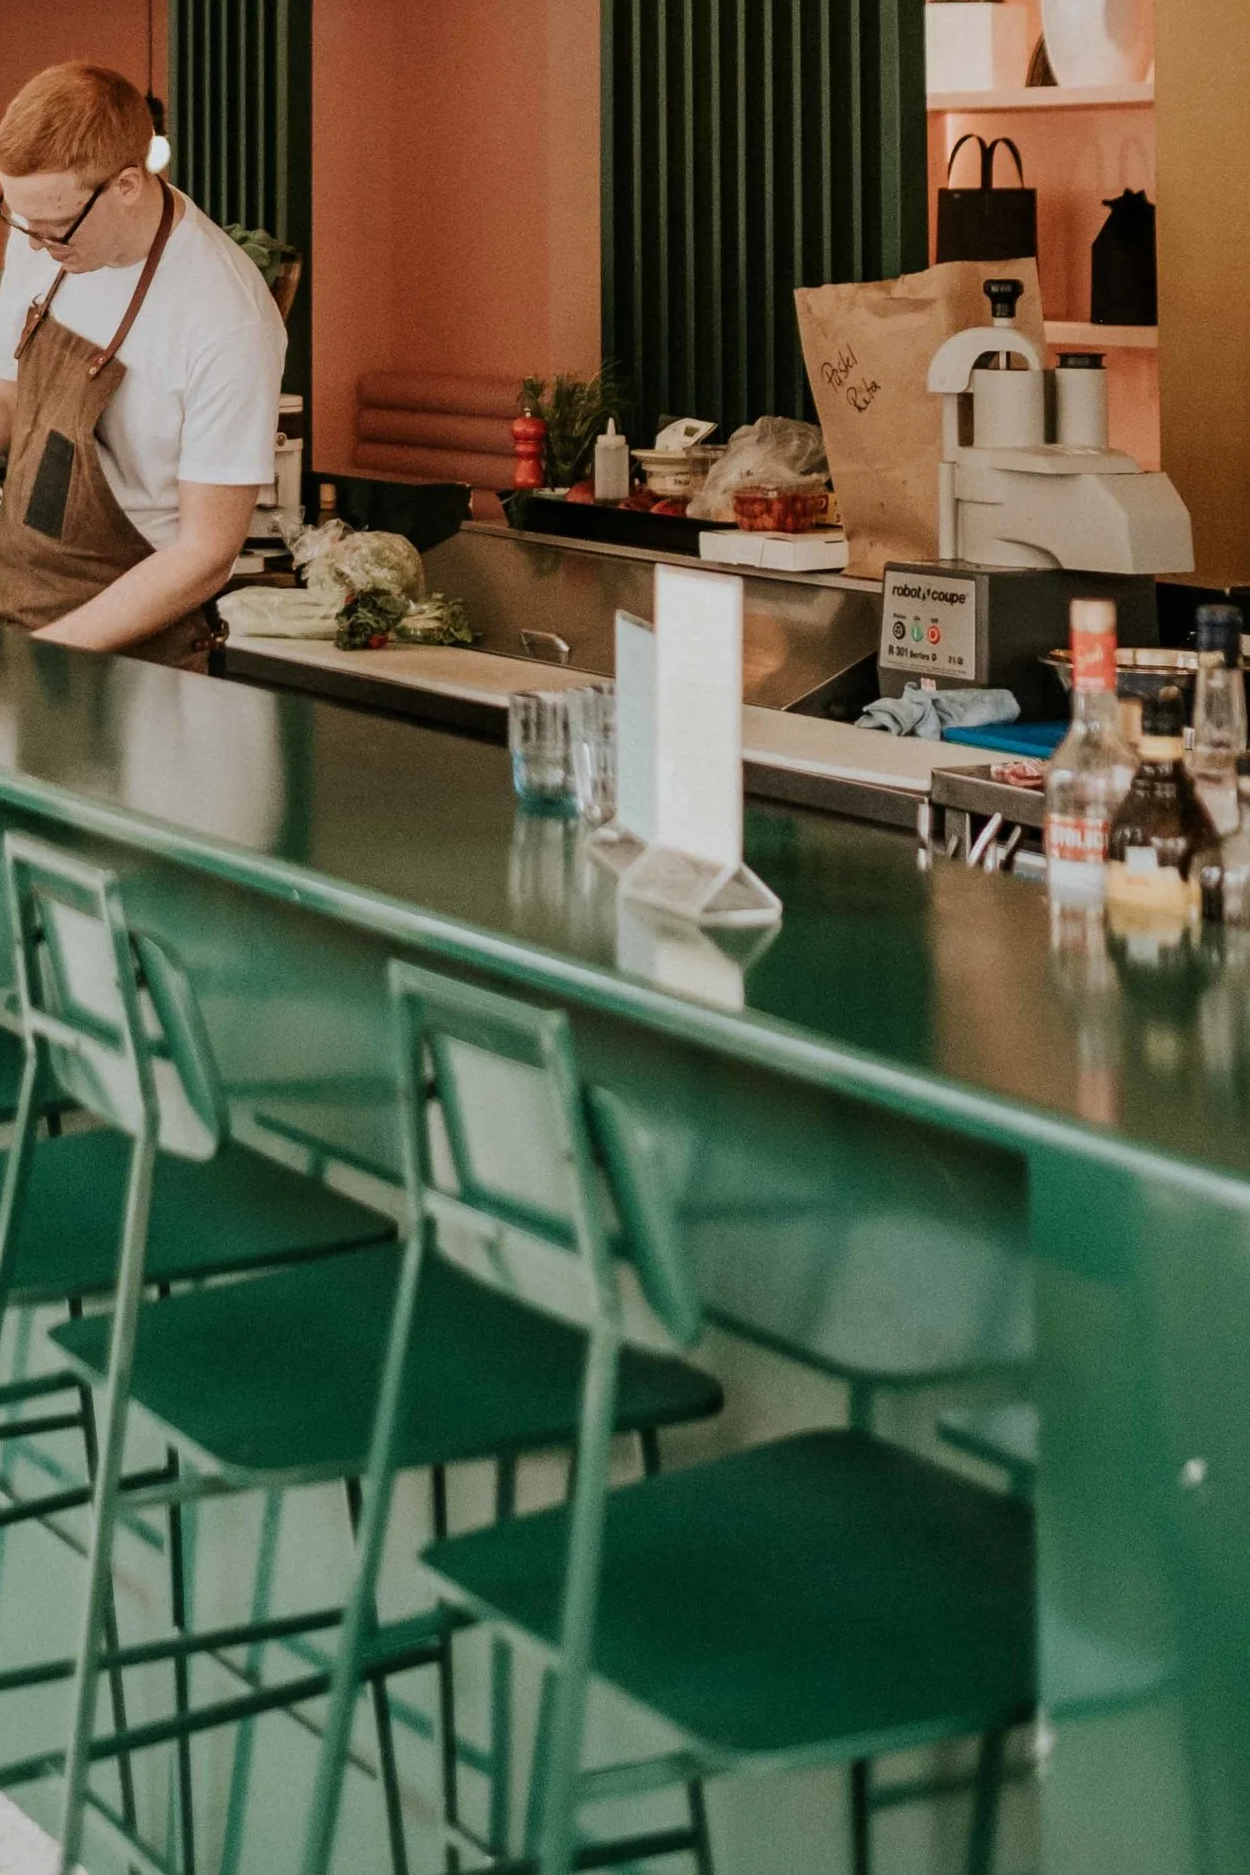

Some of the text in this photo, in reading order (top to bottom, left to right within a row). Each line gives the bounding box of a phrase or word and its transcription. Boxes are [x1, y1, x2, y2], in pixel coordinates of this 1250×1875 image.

[846, 377, 881, 413] Rita
[892, 584, 966, 605] robot coupe
[888, 644, 894, 656] R
[896, 646, 908, 656] 301
[910, 650, 929, 660] Series
